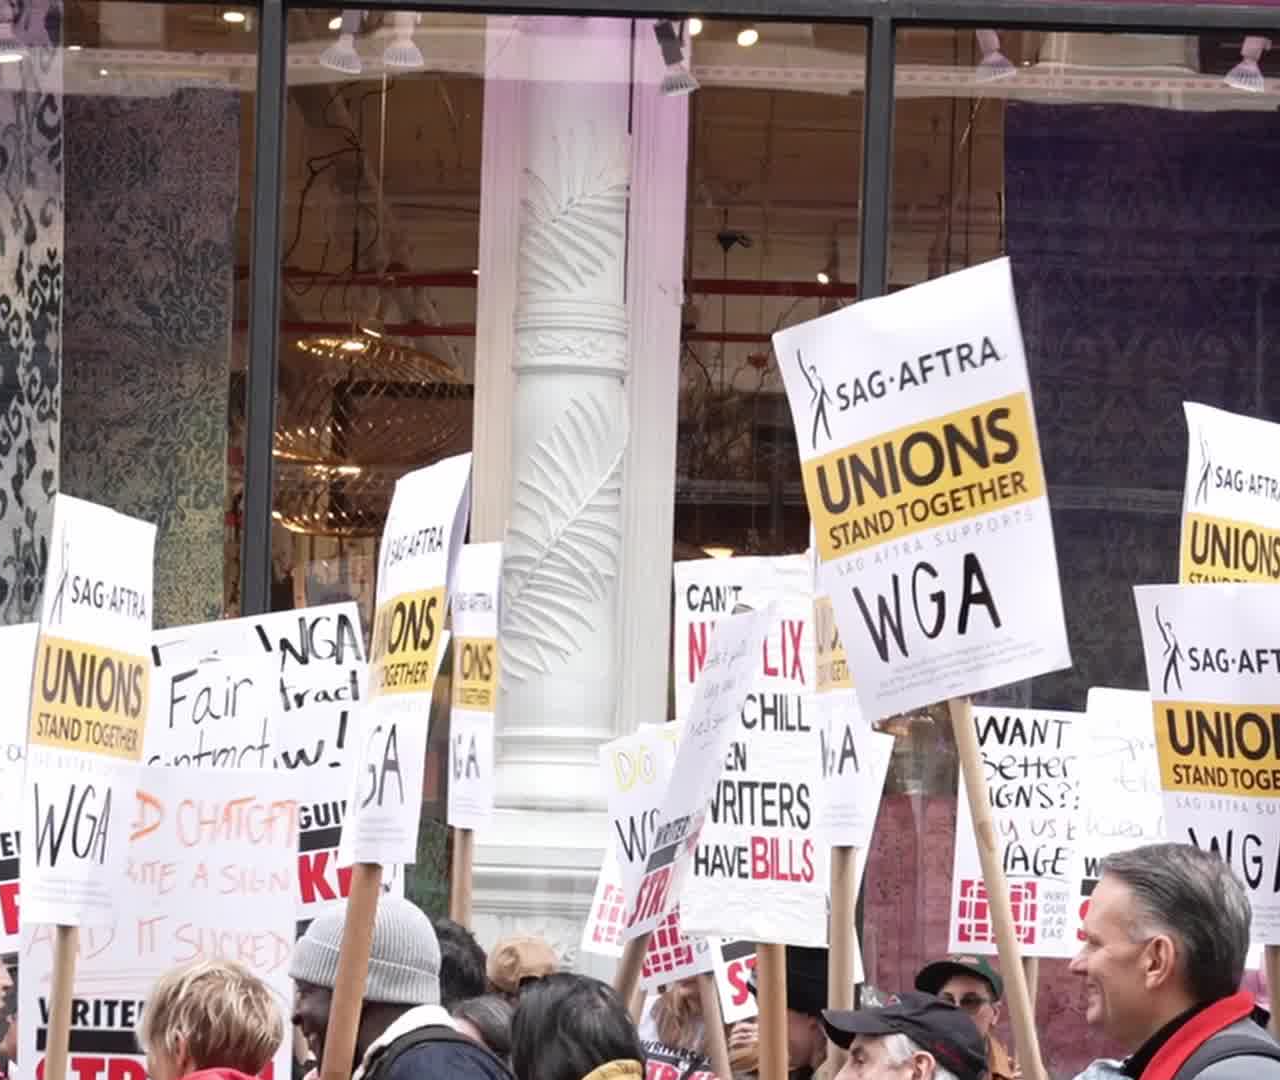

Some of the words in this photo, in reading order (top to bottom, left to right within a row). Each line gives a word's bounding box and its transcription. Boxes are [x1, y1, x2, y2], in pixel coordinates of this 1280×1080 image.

[816, 407, 1019, 515] UNIONS
[829, 509, 894, 550] STAND
[896, 471, 1027, 527] TOGETHER
[852, 552, 1001, 663] WGA
[42, 645, 145, 720] UNIONS
[169, 668, 254, 729] Fair
[36, 711, 82, 743] STAND
[84, 719, 139, 752] TOGETHER
[741, 693, 812, 733] CHILL
[974, 715, 1073, 750] WANT
[1173, 764, 1228, 788] STAND
[34, 781, 113, 868] WGA
[299, 800, 347, 830] GUI
[220, 864, 290, 894] SIGN
[694, 845, 749, 879] HAVE
[751, 836, 815, 883] BILLS
[27, 925, 117, 961] AD
[137, 915, 168, 956] IT
[175, 922, 290, 977] SUCKED
